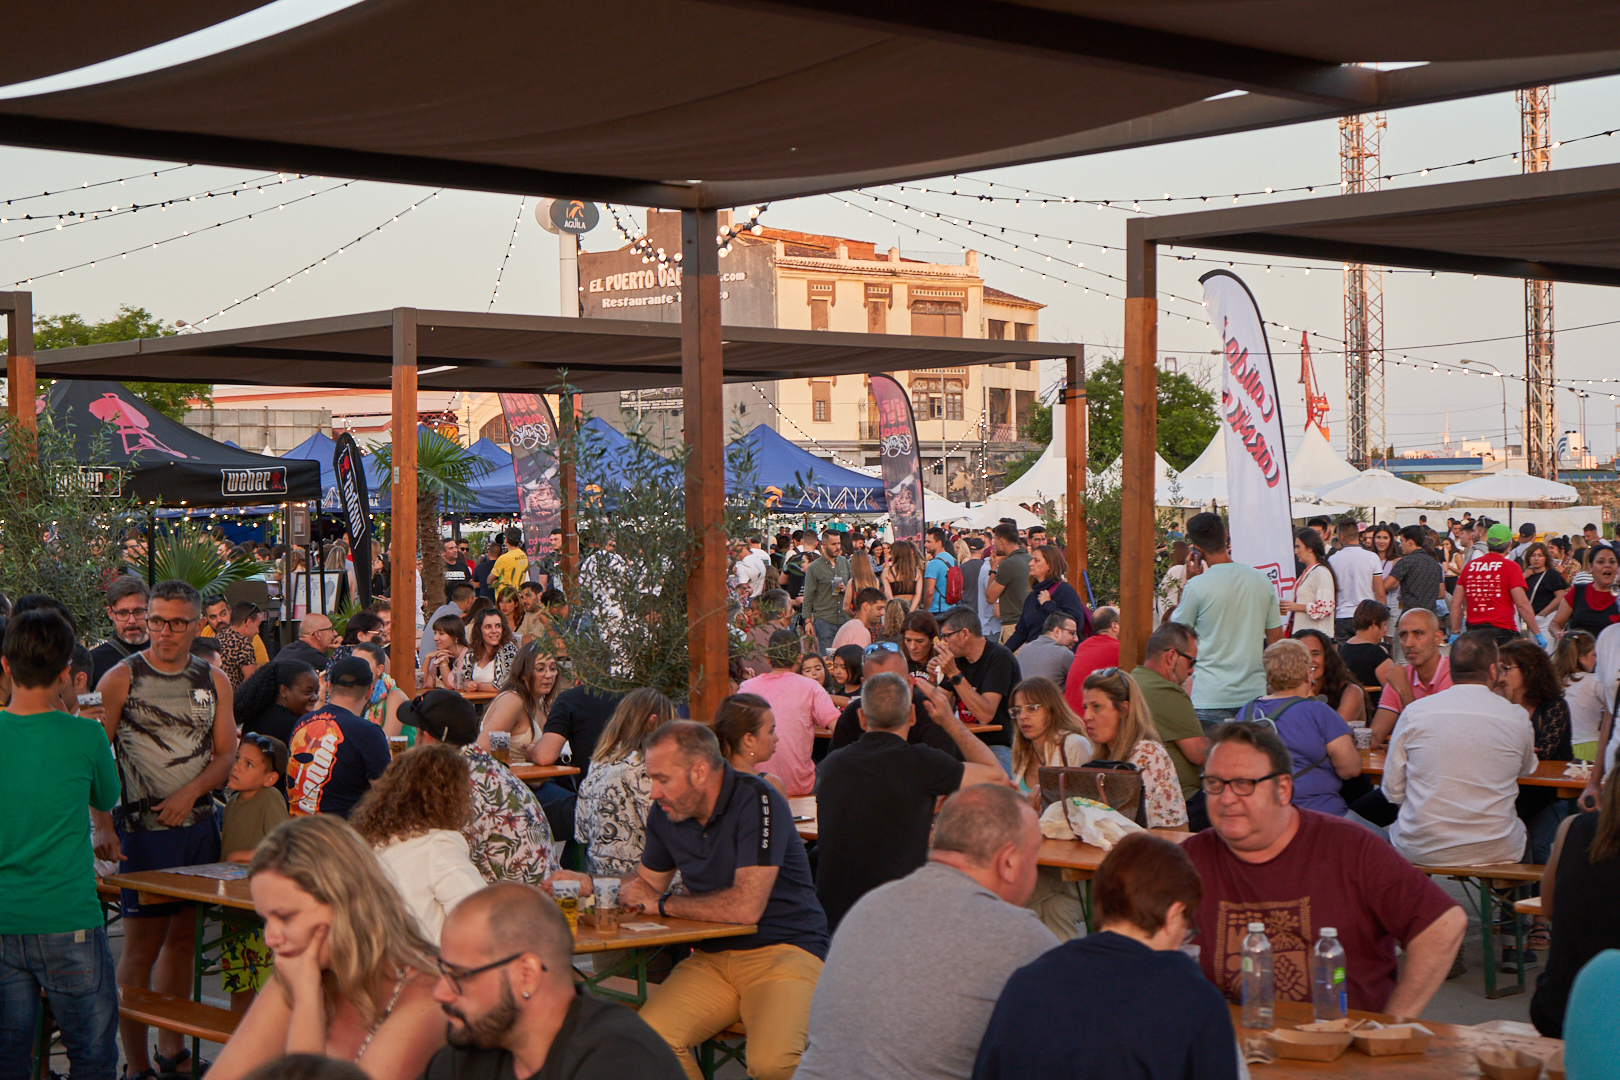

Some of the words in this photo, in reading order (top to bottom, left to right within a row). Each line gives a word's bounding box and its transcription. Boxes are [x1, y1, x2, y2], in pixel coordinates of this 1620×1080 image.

[589, 278, 604, 293] EL
[606, 269, 655, 292] PUERTO
[602, 294, 674, 308] Restaurante
[227, 470, 271, 491] weber
[1469, 561, 1503, 572] STAFF
[761, 794, 770, 849] GUESS
